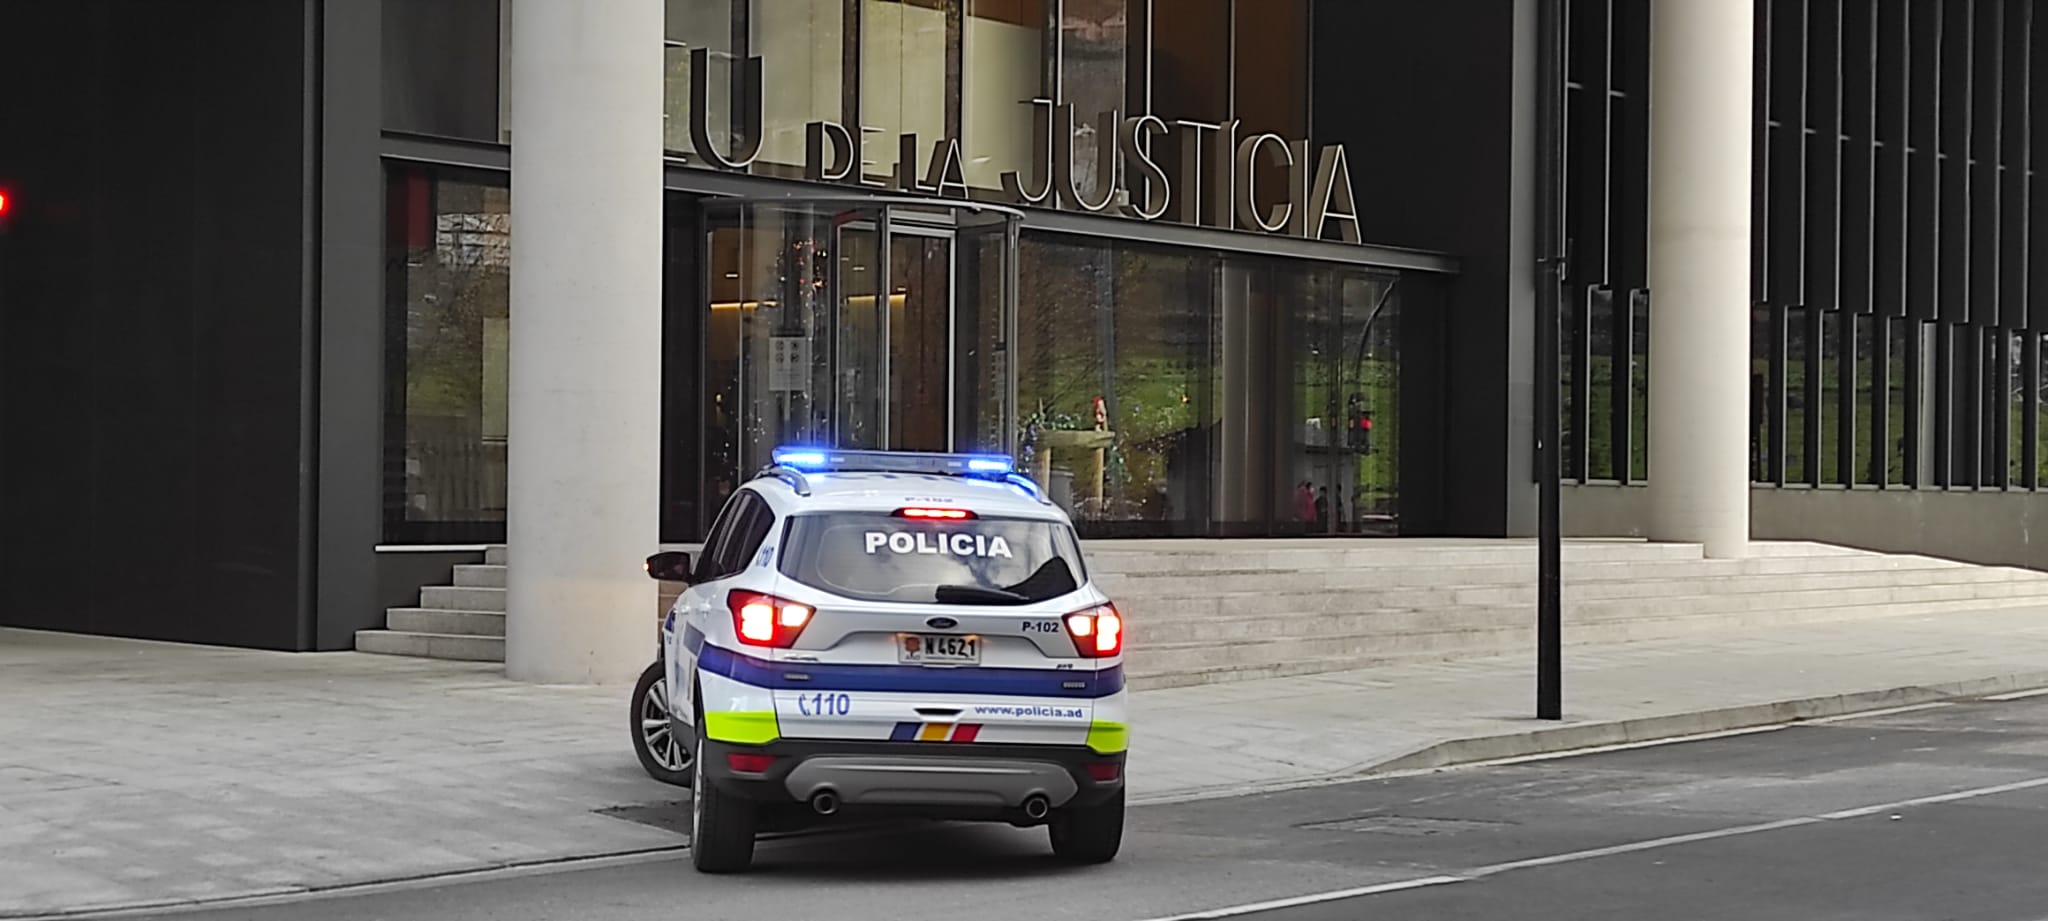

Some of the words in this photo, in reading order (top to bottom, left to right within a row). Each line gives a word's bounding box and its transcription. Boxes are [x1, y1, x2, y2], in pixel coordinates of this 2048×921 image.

[805, 120, 887, 187] DE
[895, 132, 968, 200] LA
[1000, 97, 1362, 245] JUSTÍCIA
[865, 531, 1013, 559] POLICIA
[1022, 621, 1060, 633] P-102
[812, 693, 850, 716] 110
[974, 705, 1083, 719] www.policia.ad
